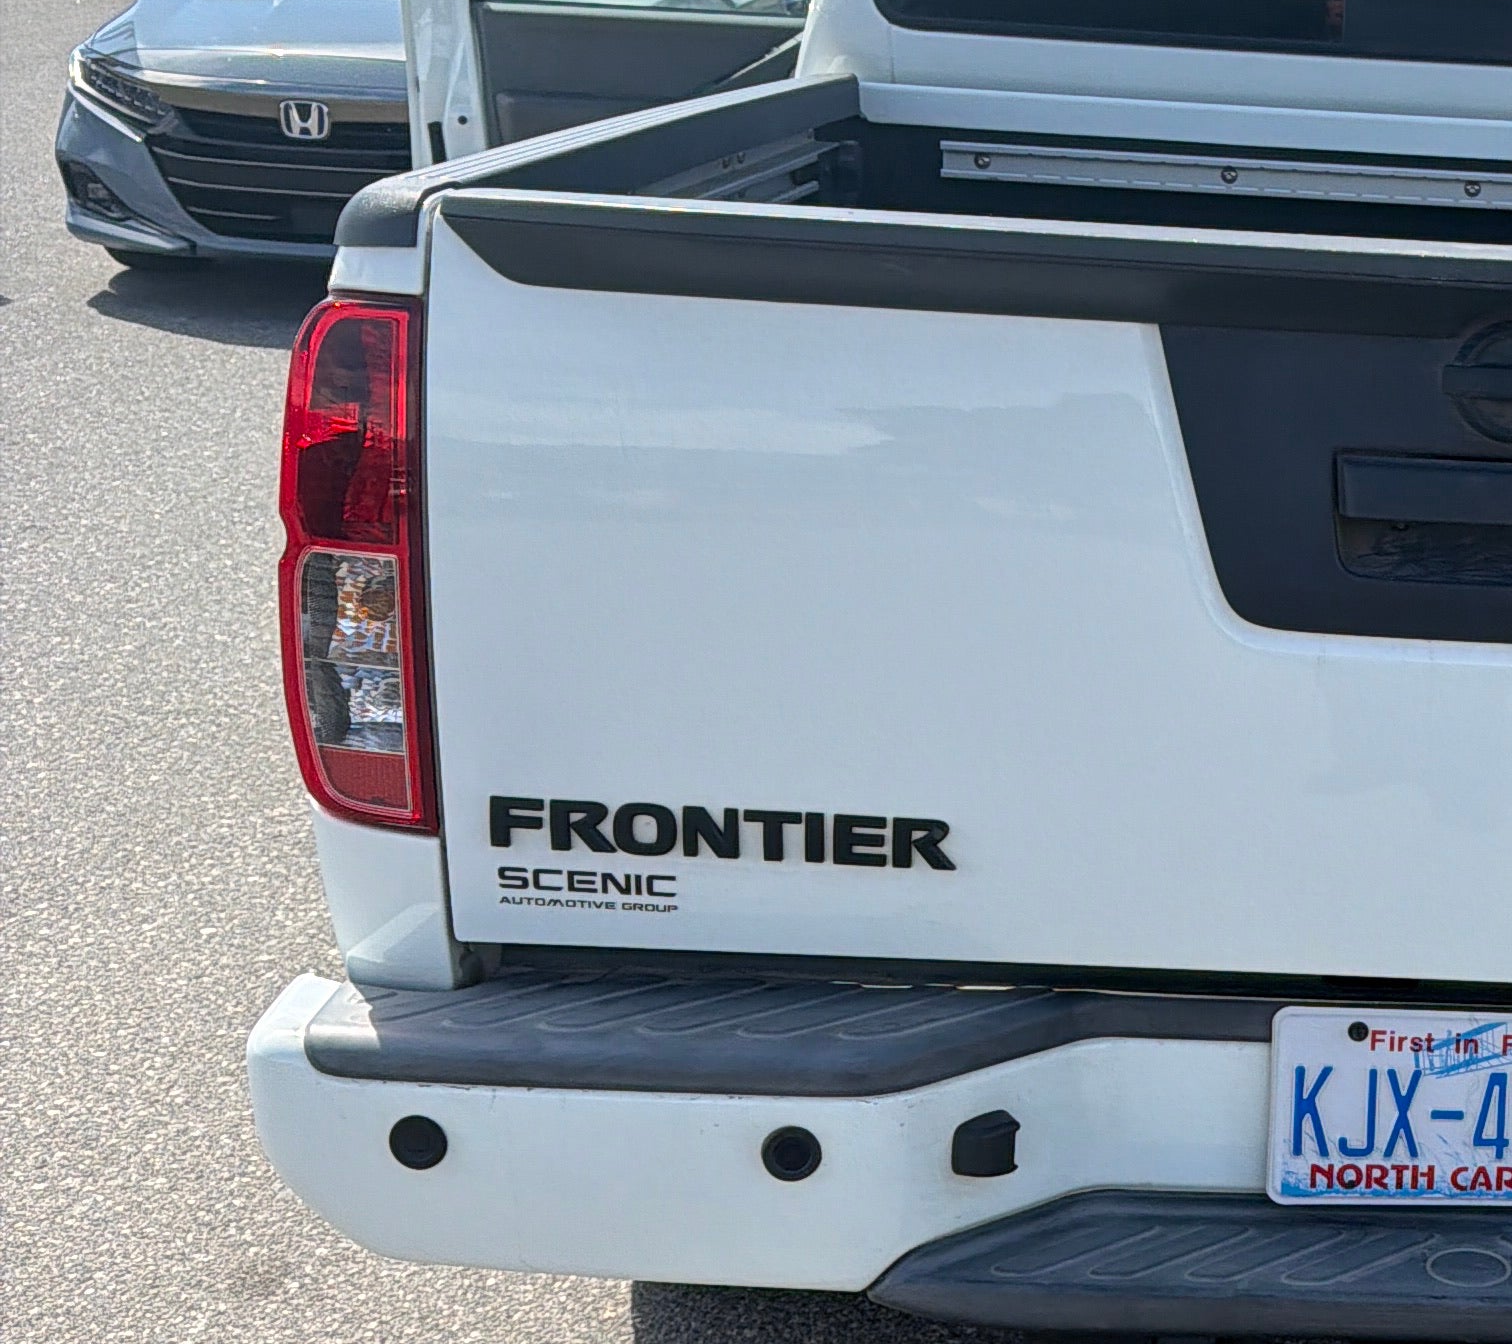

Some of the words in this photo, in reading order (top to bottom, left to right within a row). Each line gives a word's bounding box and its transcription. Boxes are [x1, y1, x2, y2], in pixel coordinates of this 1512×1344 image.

[489, 795, 957, 871] FRONTIER
[497, 866, 678, 898] SCENIC
[499, 896, 616, 911] AUTOMOTIVE
[621, 902, 679, 914] GROUP
[1369, 1029, 1435, 1054] First
[1454, 1032, 1480, 1055] in
[1309, 1163, 1435, 1190] NORTH
